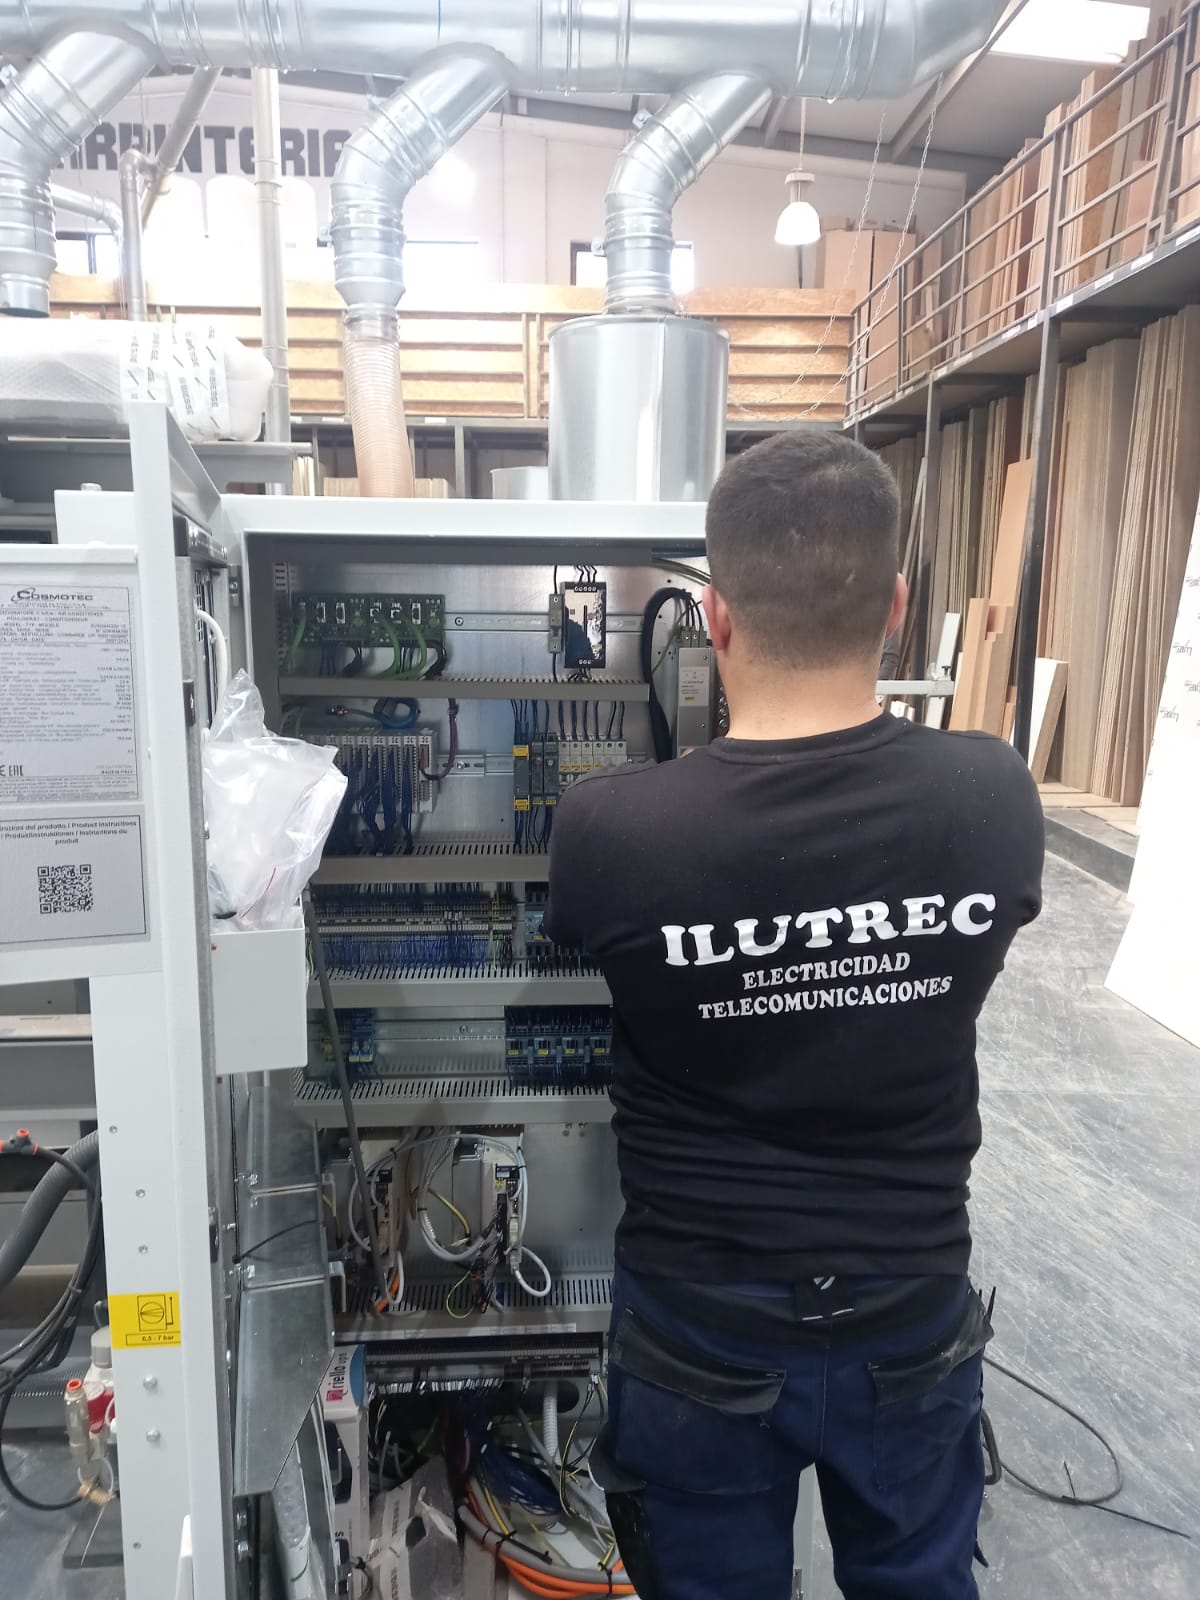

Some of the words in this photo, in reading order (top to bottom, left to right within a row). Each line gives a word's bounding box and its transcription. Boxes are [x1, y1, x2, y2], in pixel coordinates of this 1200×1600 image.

[14, 588, 93, 601] COSMOTEC
[661, 893, 996, 967] ILUTREC
[742, 952, 911, 990] ELECTRICIDAD
[699, 975, 953, 1020] TELECOMUNICACIONES
[328, 1366, 345, 1388] riello
